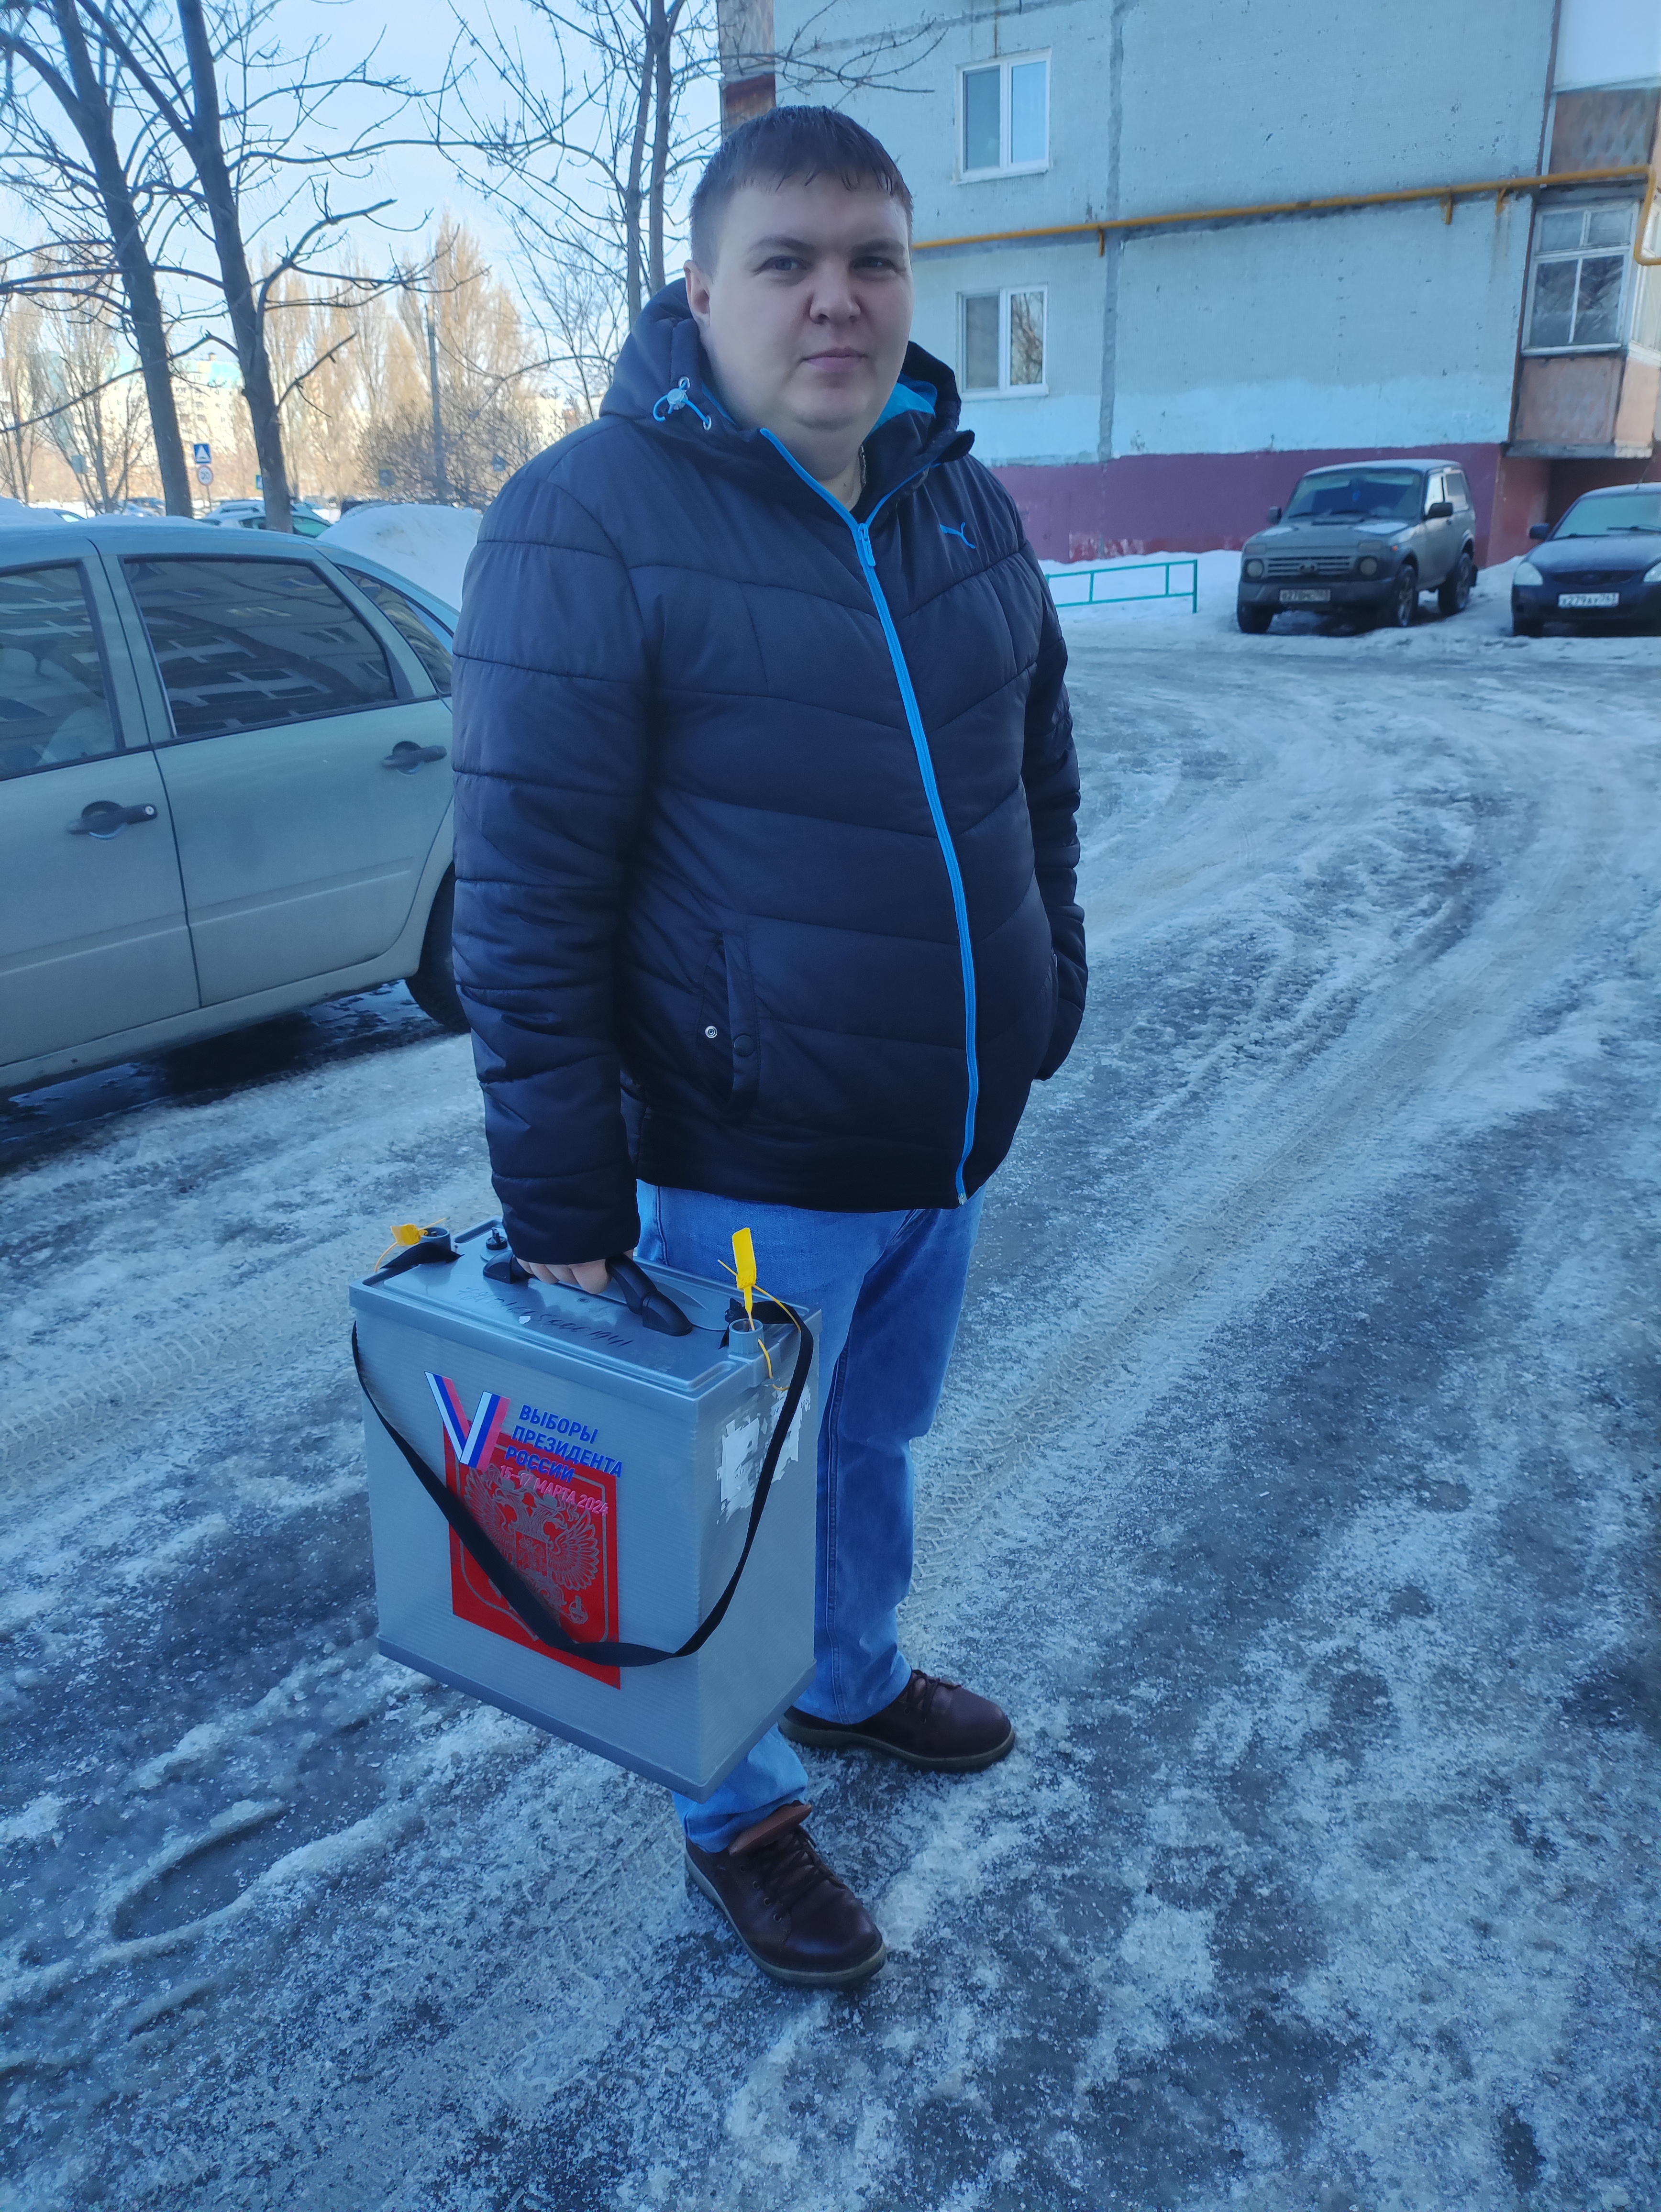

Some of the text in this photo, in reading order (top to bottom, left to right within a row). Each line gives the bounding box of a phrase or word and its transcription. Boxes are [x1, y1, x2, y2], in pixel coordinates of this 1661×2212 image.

[519, 1404, 598, 1444] ВЫБОРЫ
[504, 1446, 575, 1482] РОССИИ
[511, 1425, 622, 1477] ПРЕЗИДЕНТА
[533, 1478, 576, 1504] МАРТА
[577, 1494, 609, 1516] 2024
